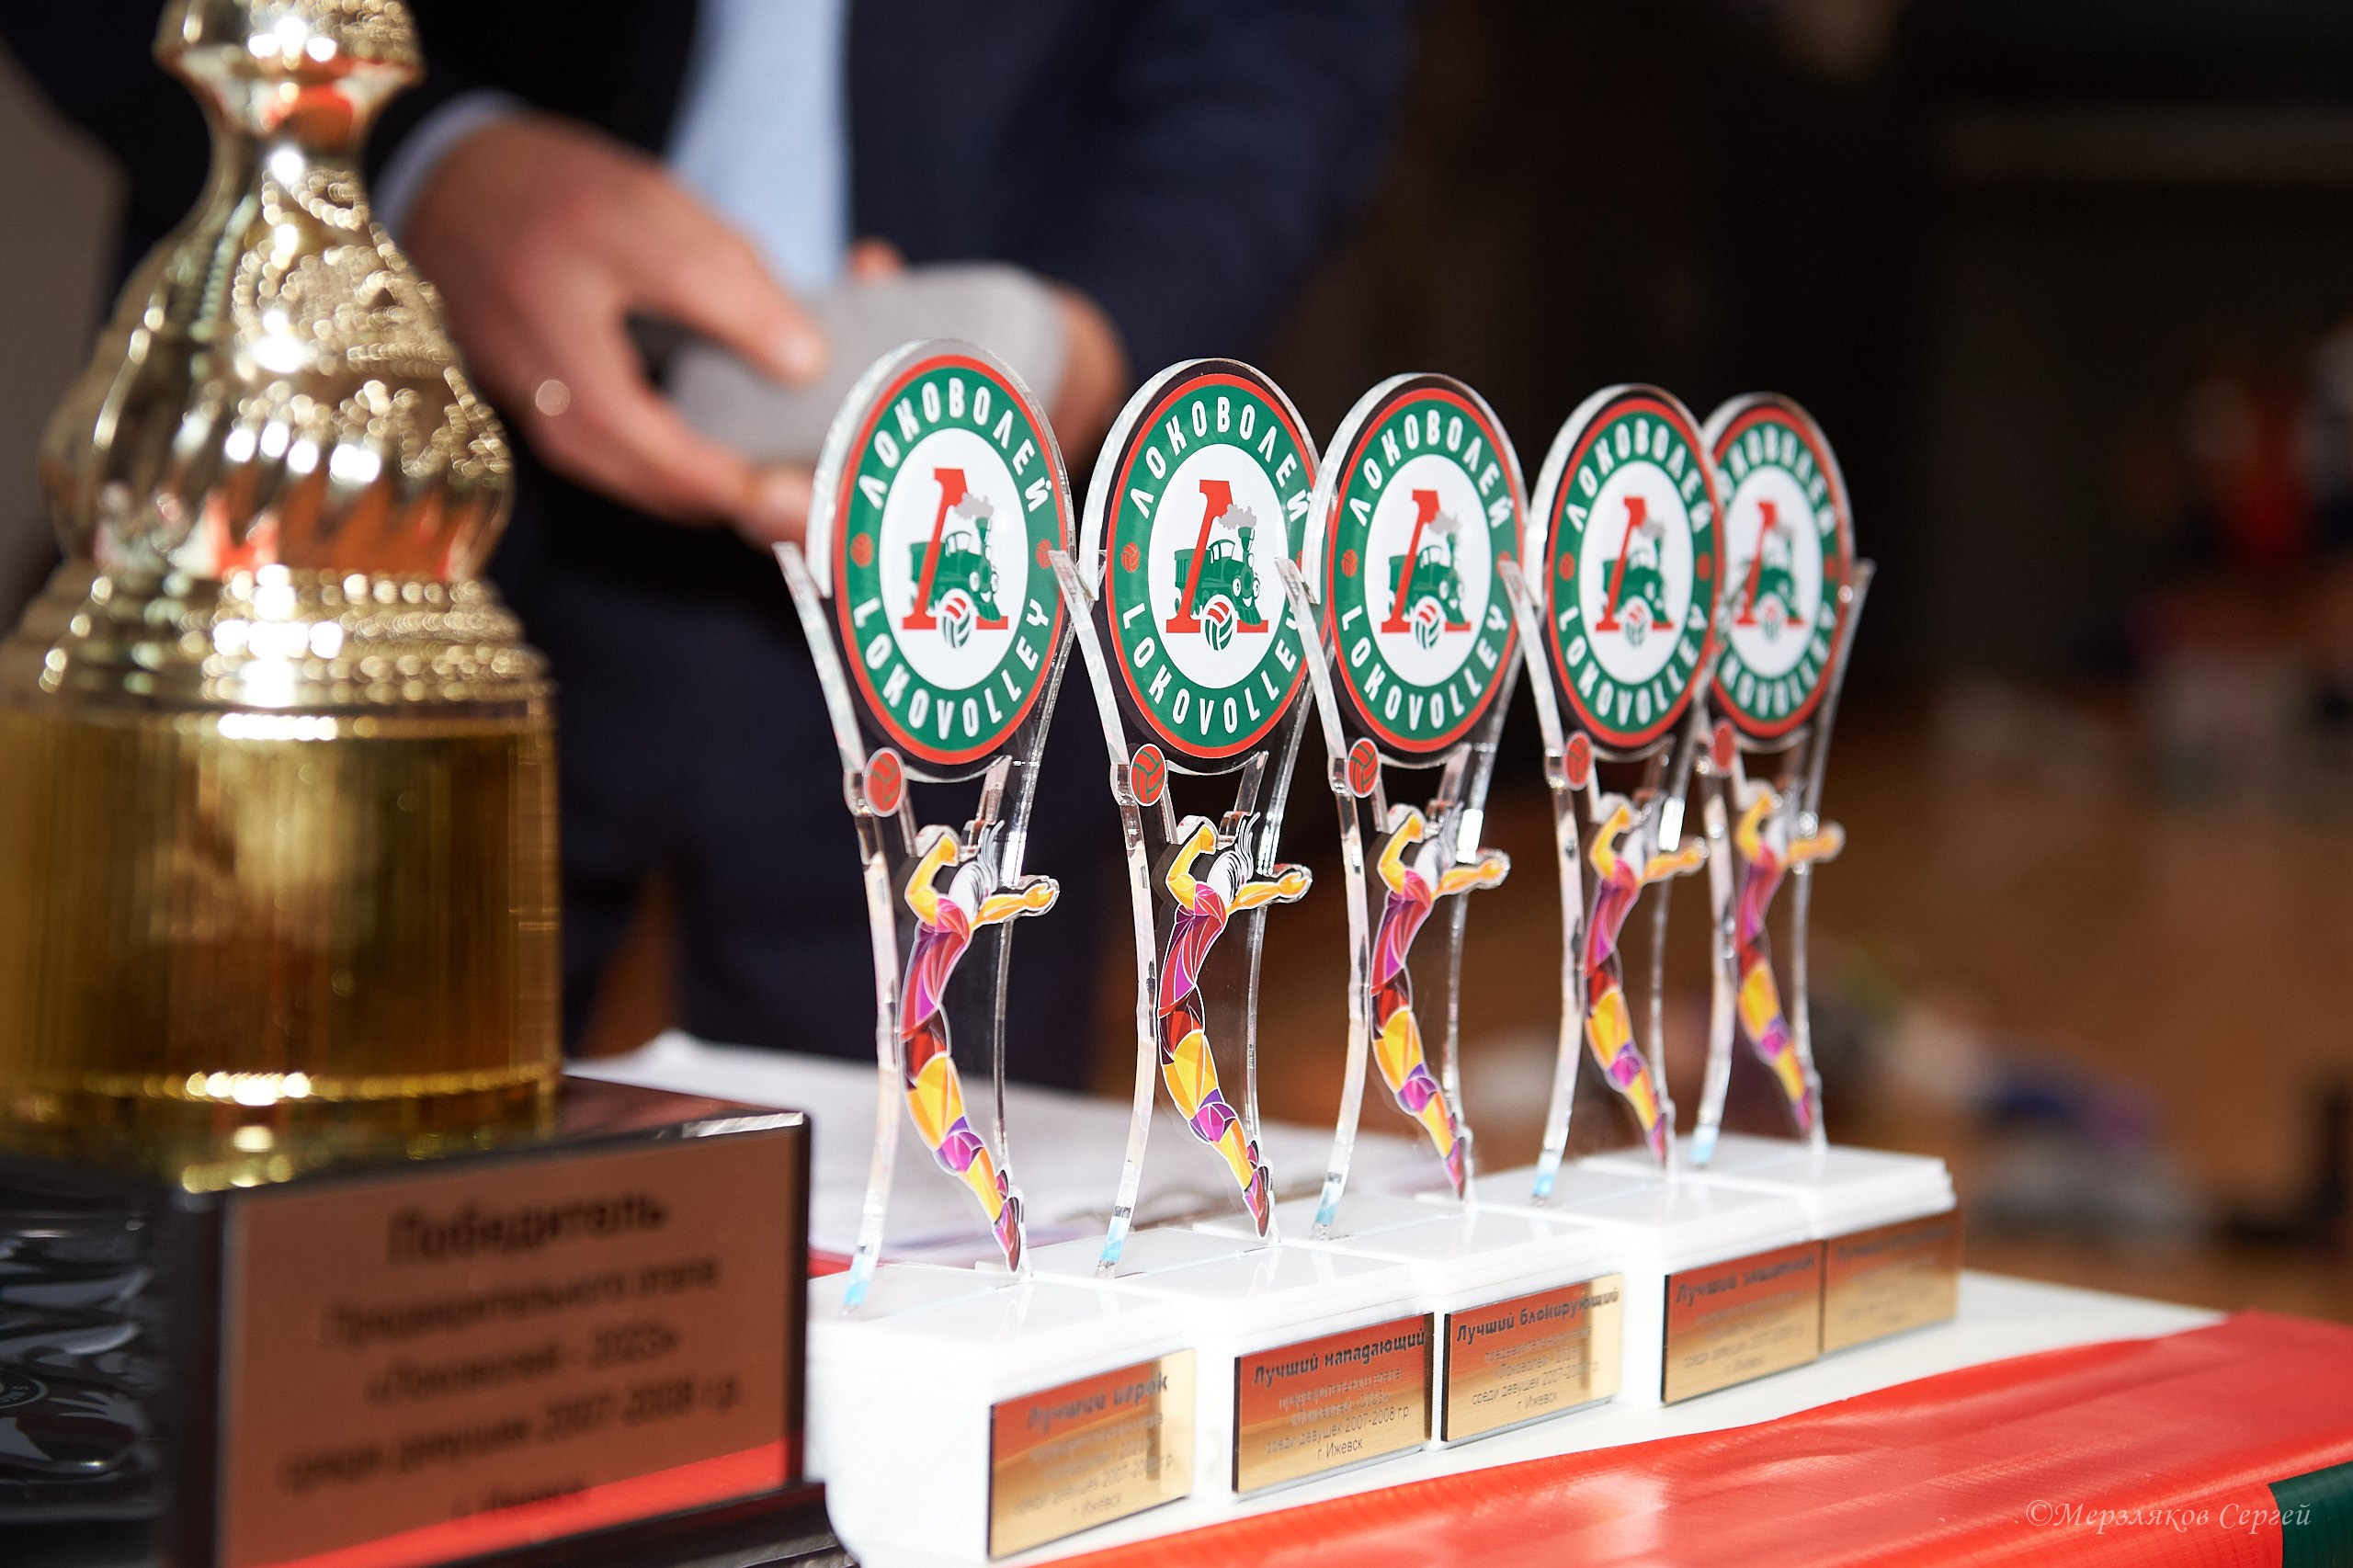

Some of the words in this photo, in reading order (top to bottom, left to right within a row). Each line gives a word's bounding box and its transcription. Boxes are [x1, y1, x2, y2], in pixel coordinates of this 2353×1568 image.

[858, 378, 1053, 513] ЛОКОВОЛЕЙ
[1131, 396, 1313, 523] ЛОКОВОЛЕЙ
[1349, 409, 1515, 528] ЛОКОВОЛЕЙ
[1566, 417, 1713, 533] ЛОКОВОЛЕЙ
[1716, 424, 1836, 535] ОКОВОЛЕЙ
[853, 597, 1049, 740] LOKOVOLLEY
[1342, 603, 1508, 731] LOKOVOLLEY
[1559, 603, 1708, 726] LOKOVOLLEY
[1721, 601, 1836, 719] KOVOLLEY
[1254, 1353, 1319, 1388] Лучший
[1324, 1328, 1425, 1367] нападающий
[1457, 1312, 1515, 1345] Лучший
[1519, 1288, 1619, 1326] блокирующий
[1113, 1372, 1167, 1406] игрок
[1300, 1423, 1342, 1445] девушек
[1345, 1406, 1395, 1433] 2007-2008
[1326, 1437, 1364, 1459] Ижевск
